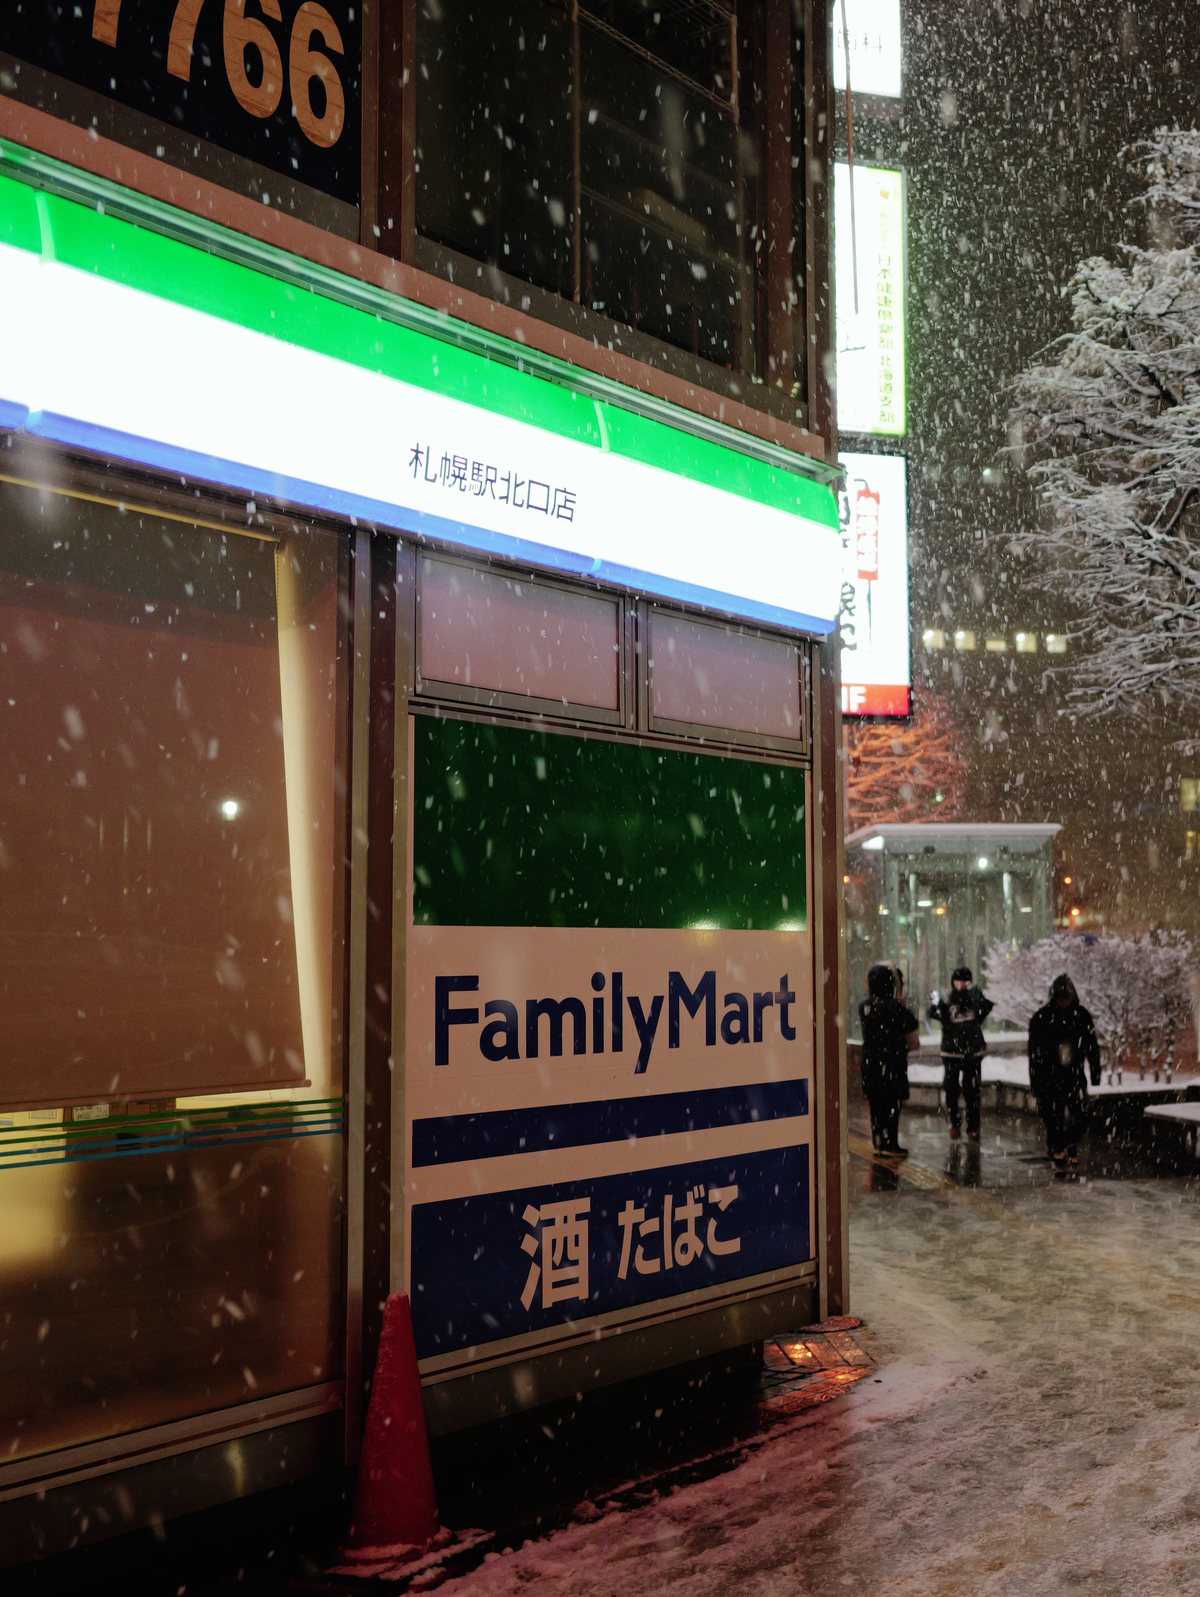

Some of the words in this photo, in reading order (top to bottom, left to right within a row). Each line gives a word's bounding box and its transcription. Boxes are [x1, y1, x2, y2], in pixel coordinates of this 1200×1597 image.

[408, 442, 577, 523] 札幌駅北口店
[434, 971, 797, 1075] FamilyMart
[519, 1196, 592, 1313] 酒
[617, 1183, 742, 1281] たばこ
